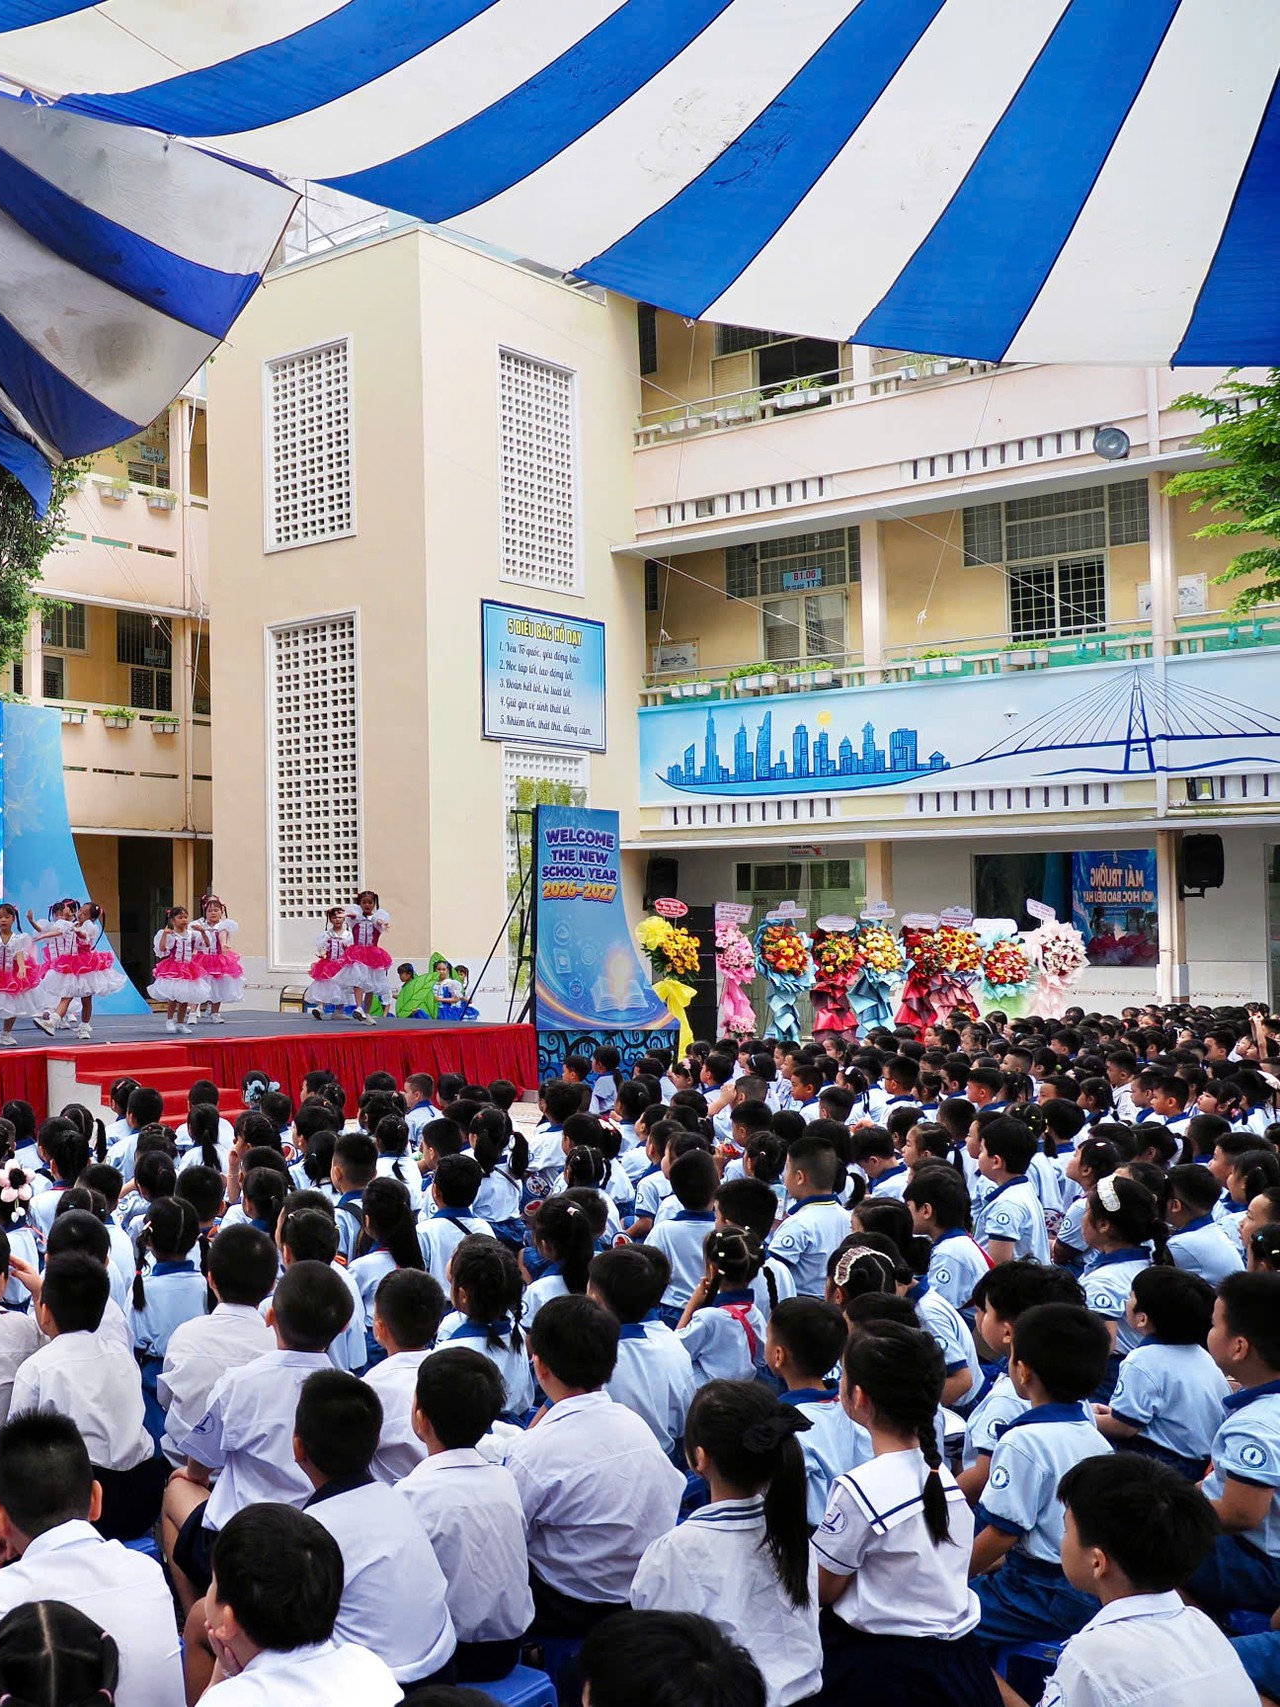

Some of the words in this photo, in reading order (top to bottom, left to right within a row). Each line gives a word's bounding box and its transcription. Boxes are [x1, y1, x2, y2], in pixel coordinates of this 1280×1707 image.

[793, 570, 816, 581] B1.06
[807, 579, 822, 588] 1T3
[508, 618, 514, 635] 5
[536, 621, 552, 642] BÁC
[566, 629, 582, 649] DẠY
[500, 660, 506, 670] 2.
[500, 678, 506, 688] 3.
[500, 714, 506, 725] 5.
[545, 828, 615, 849] WELCOME
[551, 849, 576, 862] THE
[579, 850, 609, 866] NEW
[542, 864, 586, 880] SCHOOL
[588, 866, 617, 882] YEAR
